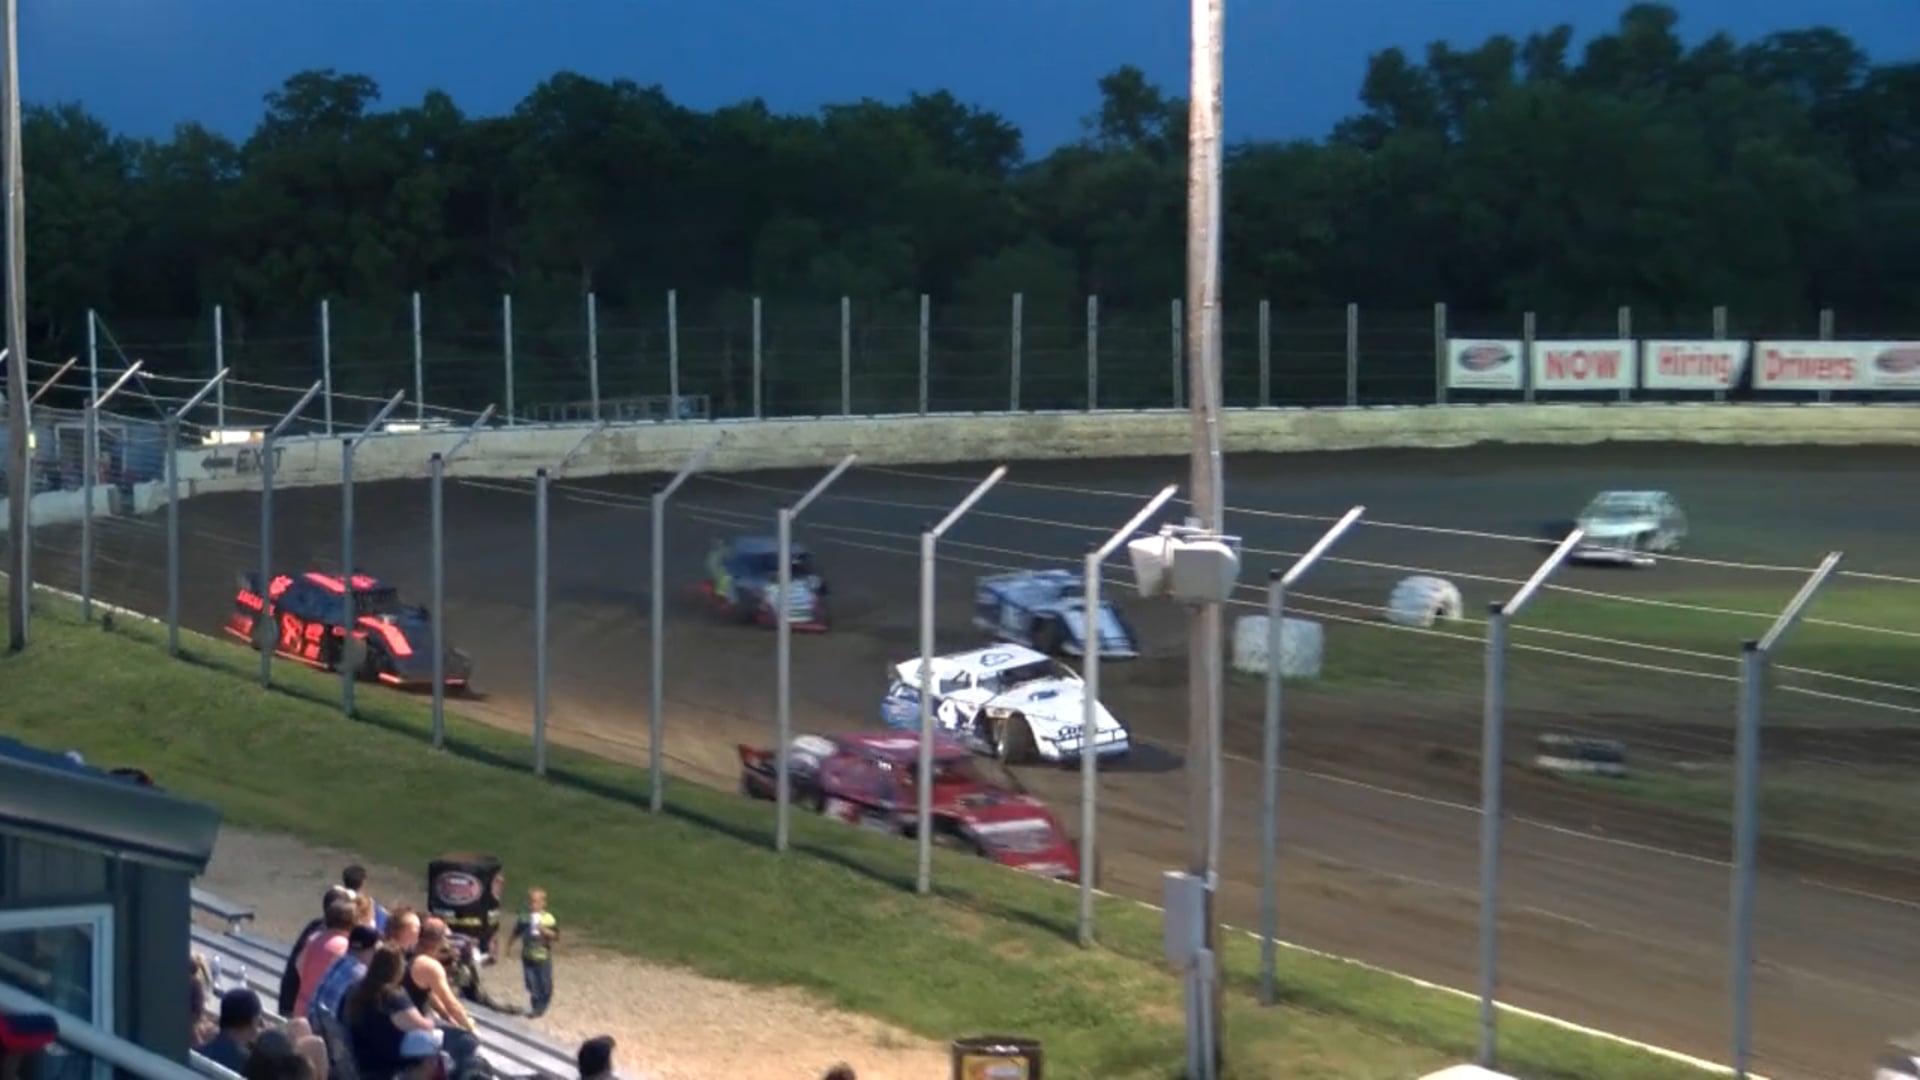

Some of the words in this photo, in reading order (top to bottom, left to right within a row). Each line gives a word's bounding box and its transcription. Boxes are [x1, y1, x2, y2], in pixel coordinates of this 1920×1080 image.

[1545, 350, 1621, 380] NOW
[1658, 345, 1731, 384] Hiring
[1766, 349, 1857, 380] Drivers
[236, 446, 287, 474] EXT
